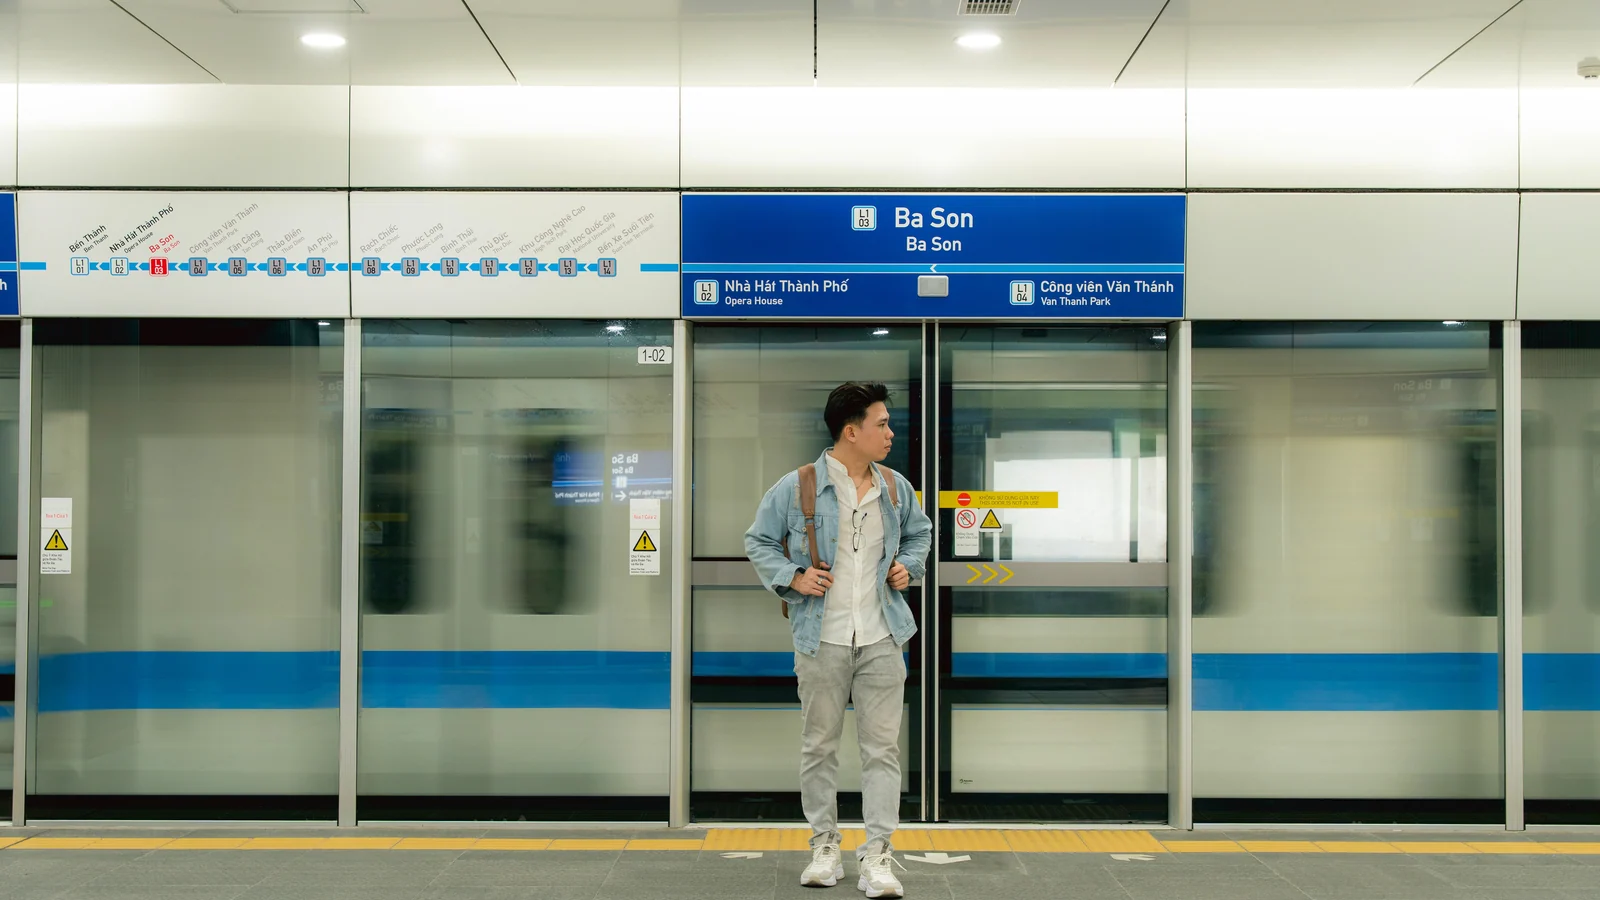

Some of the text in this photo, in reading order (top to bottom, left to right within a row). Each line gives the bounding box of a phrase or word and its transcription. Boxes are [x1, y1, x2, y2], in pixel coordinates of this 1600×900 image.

[602, 211, 616, 223] Gia
[859, 209, 869, 218] L1
[895, 206, 974, 228] Ba Son
[858, 218, 870, 227] 03
[109, 203, 174, 253] Nhà Hát Thành Phố
[423, 223, 444, 238] Long
[518, 242, 535, 254] Khu
[571, 205, 586, 217] Cao
[69, 225, 107, 253] Bến Thành
[124, 231, 154, 254] Opera House
[149, 233, 175, 253] Ba Son
[572, 222, 616, 254] National University
[611, 234, 623, 244] Xe
[83, 234, 109, 253] Ben Thanh
[163, 240, 181, 254] Ba Son
[906, 236, 962, 252] Ba Son
[306, 244, 318, 254] An
[563, 260, 572, 268] L1
[602, 260, 611, 268] L1
[193, 267, 203, 275] 04
[233, 267, 242, 275] 05
[272, 267, 282, 275] 06
[311, 267, 321, 275] 07
[366, 267, 376, 275] 08
[406, 267, 416, 275] 09
[446, 267, 454, 275] 10
[486, 267, 493, 275] 11
[701, 284, 712, 292] L1
[724, 278, 850, 292] Nhà Hát Thành Phố
[1017, 283, 1027, 292] L1
[1040, 280, 1174, 295] Công viên Văn Thánh
[700, 292, 712, 301] 02
[725, 296, 783, 306] Opera House
[1016, 293, 1028, 302] 04
[1041, 297, 1111, 306] Van Thanh Park
[642, 349, 665, 362] 1-02
